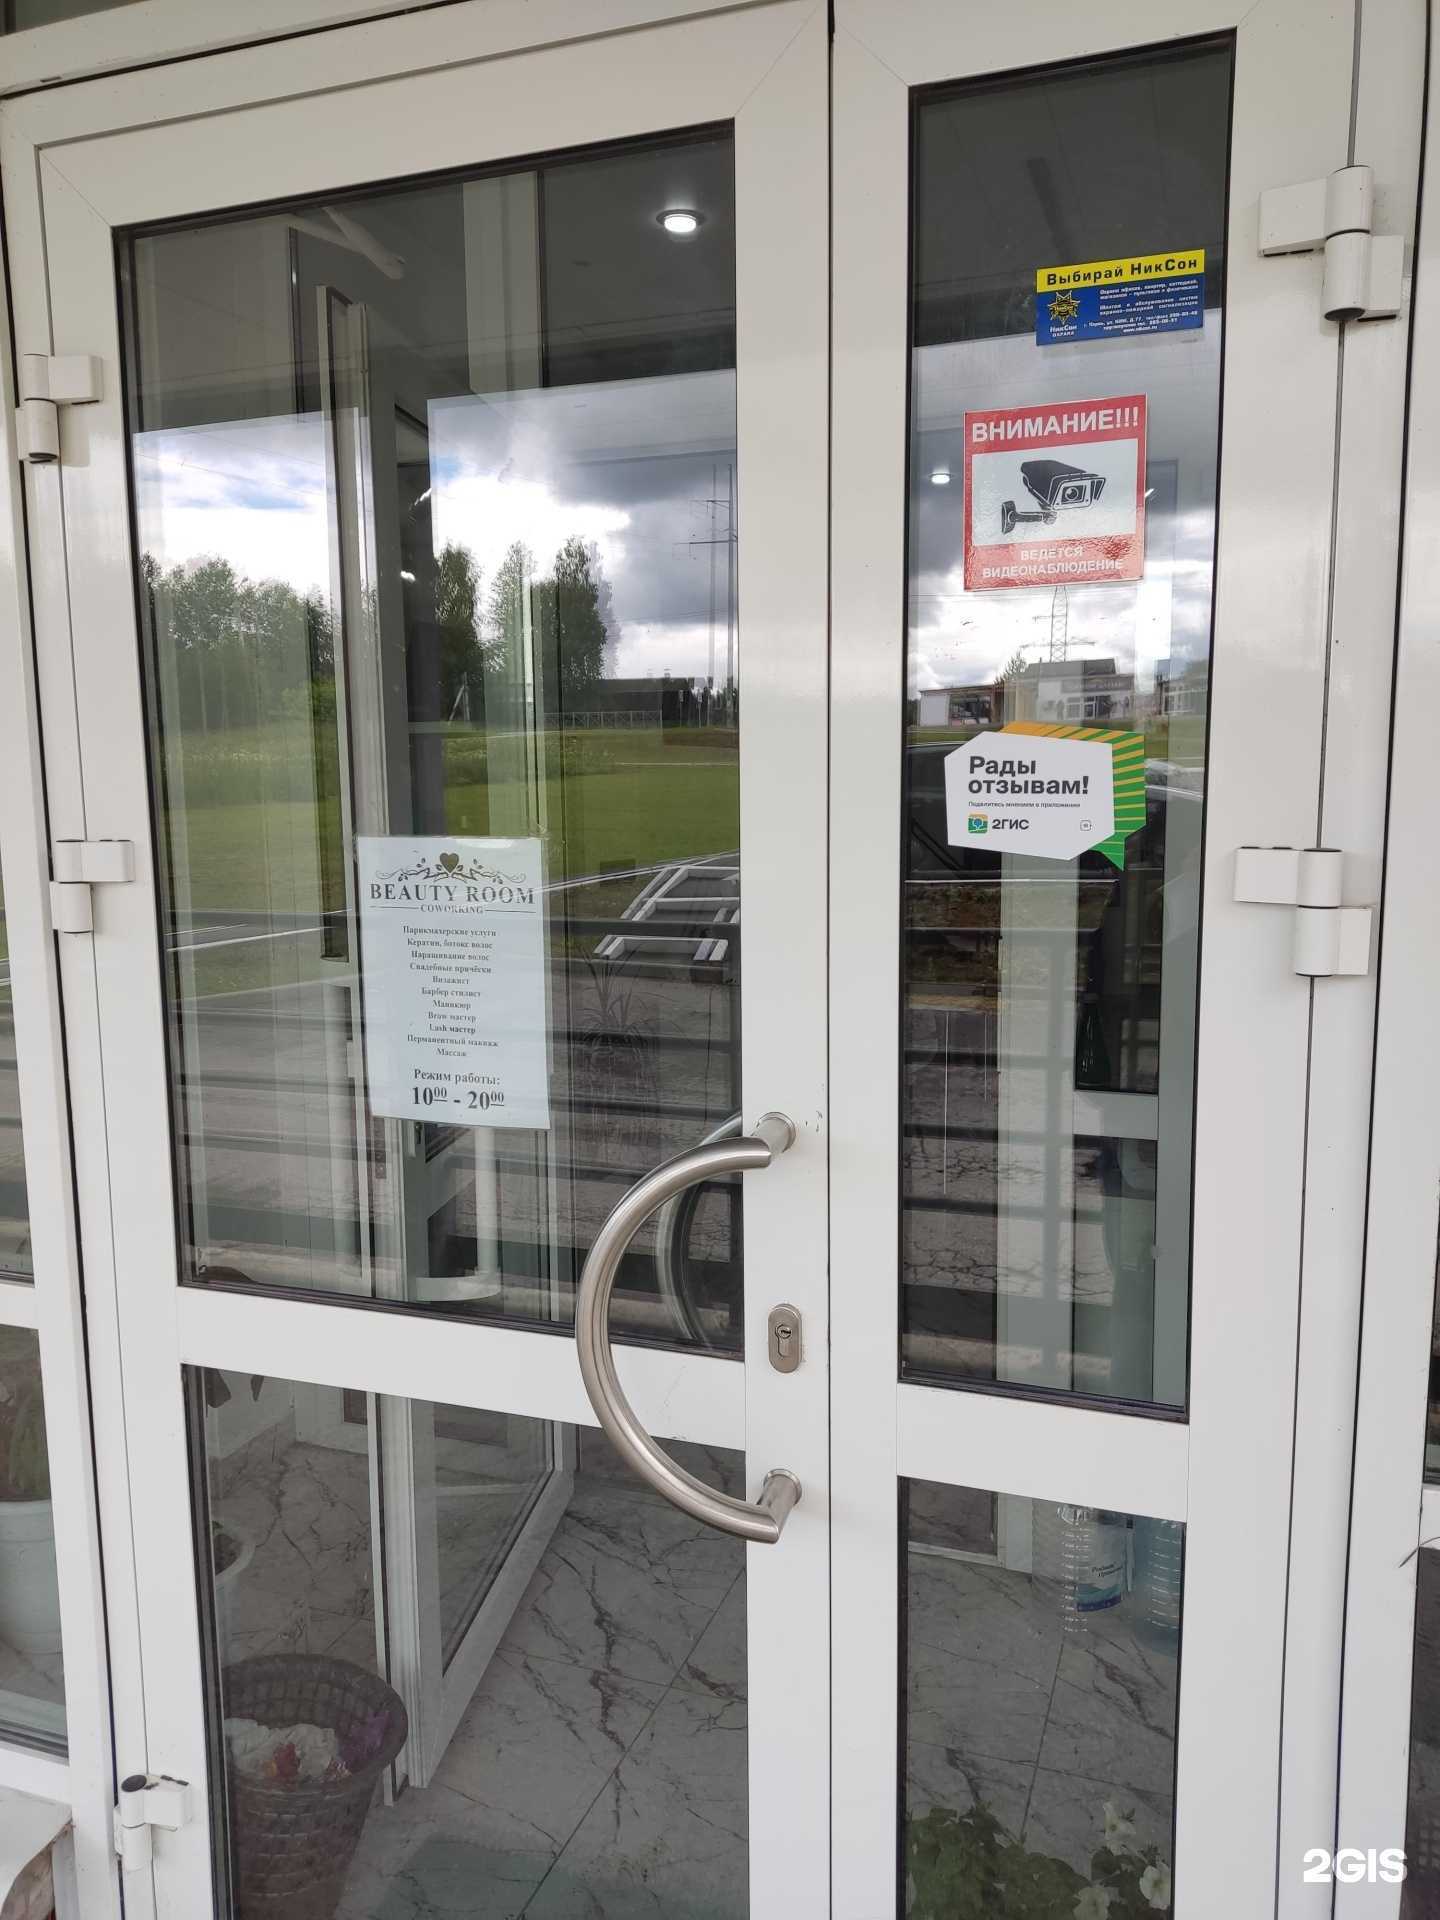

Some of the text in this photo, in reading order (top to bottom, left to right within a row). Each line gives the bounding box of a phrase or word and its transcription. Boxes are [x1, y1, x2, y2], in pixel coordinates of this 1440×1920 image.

[1047, 258, 1197, 286] Выбирай НикСон
[972, 406, 1139, 443] ВНИМАНИЕ!!!
[1020, 546, 1083, 561] ВЕДЕТСЯ
[982, 559, 1123, 579] ВИДЕОНАБЛЮДЕНИЕ
[969, 756, 1036, 777] Рады
[968, 775, 1089, 795] отзывам!
[992, 818, 1029, 830] 2ГИС
[370, 884, 535, 904] BEAUTY ROOM
[420, 904, 484, 914] COWORKING
[403, 926, 497, 938] Парикмахерские услуги
[407, 938, 442, 947] Кератин,
[443, 939, 469, 948] ботокс
[410, 962, 453, 972] Свадебные
[422, 987, 449, 997] Барбер
[433, 1000, 471, 1010] Маникюр
[448, 1026, 476, 1035] мастер
[407, 1034, 466, 1045] Перманентный
[436, 1048, 467, 1057] Массаж
[414, 1068, 501, 1085] Режим работы:
